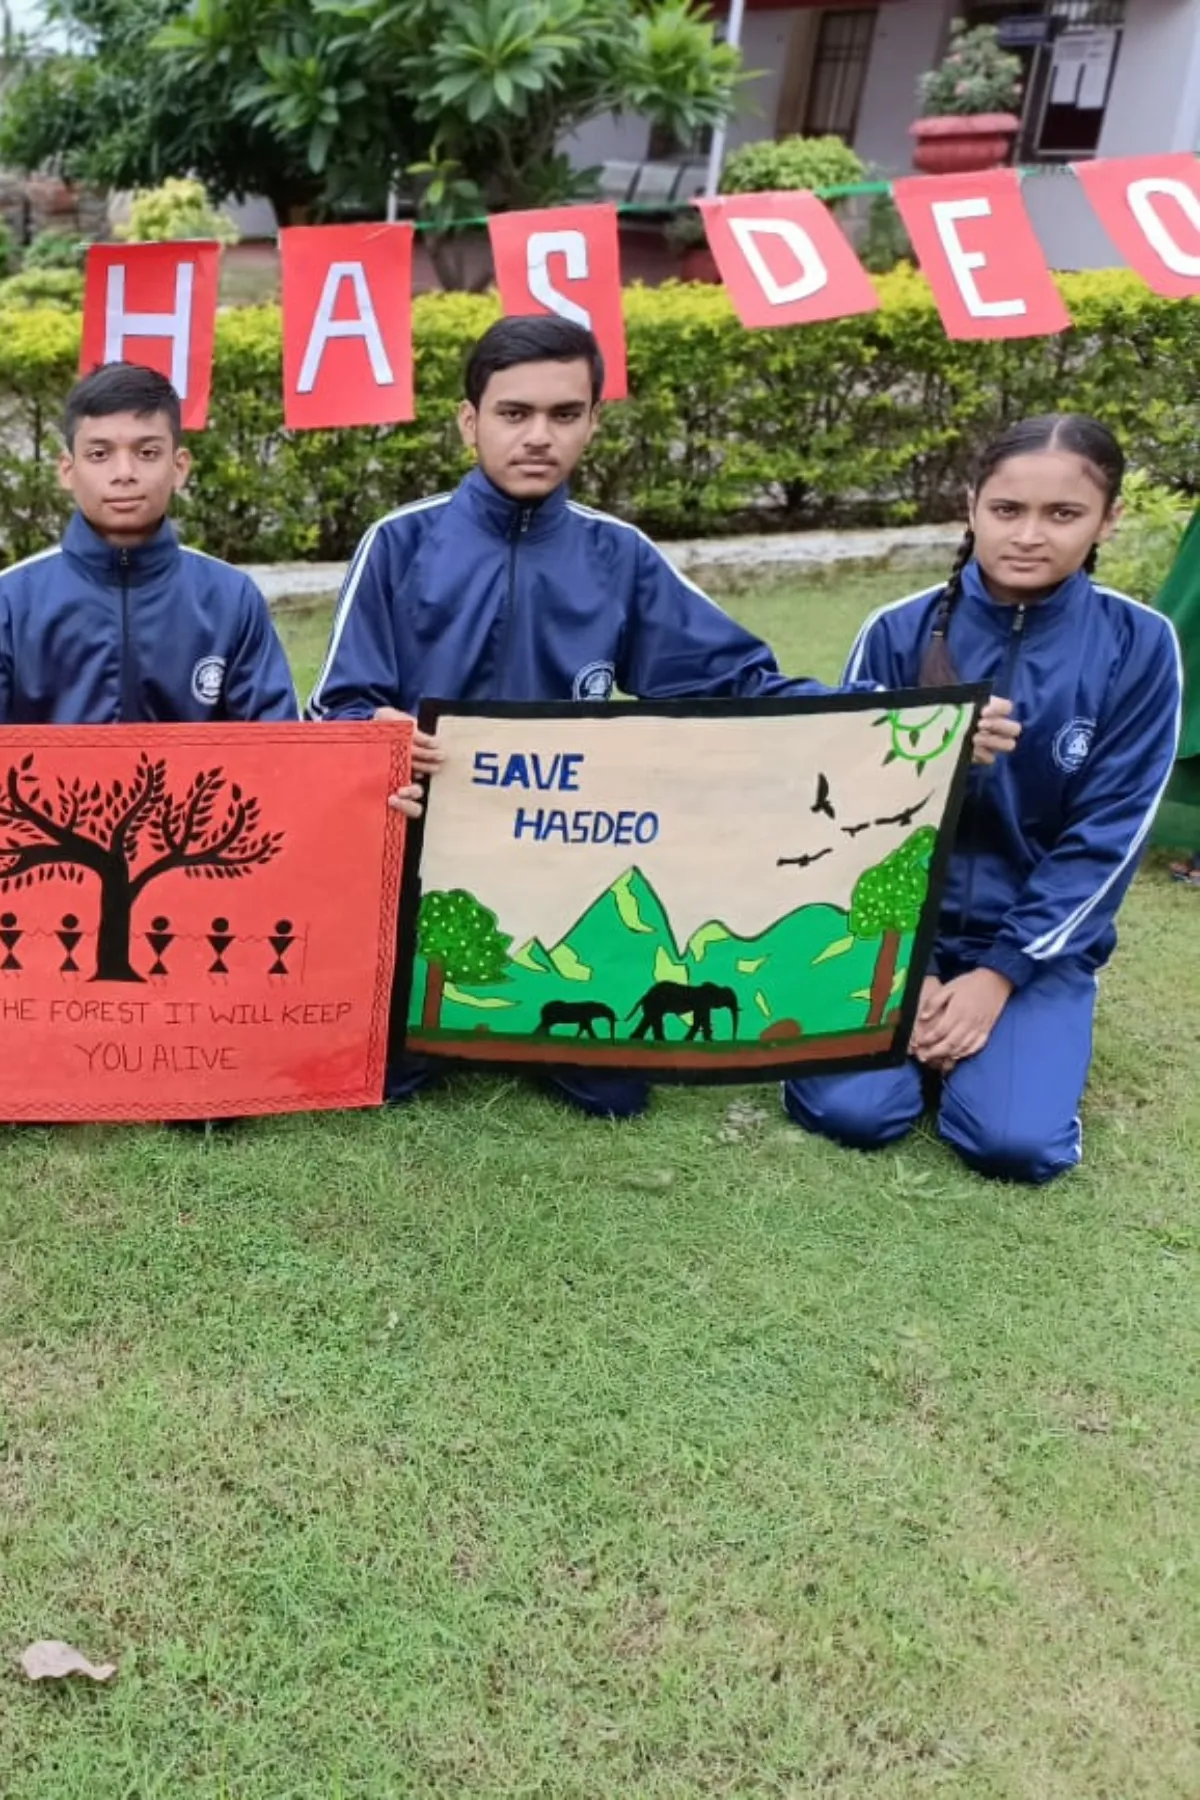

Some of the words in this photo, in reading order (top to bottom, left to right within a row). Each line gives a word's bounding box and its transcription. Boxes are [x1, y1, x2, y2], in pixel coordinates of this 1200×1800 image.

[471, 752, 584, 791] SAVE
[514, 807, 659, 846] HASDEO
[50, 1000, 151, 1025] FOREST
[165, 1002, 202, 1025] IT
[209, 1003, 274, 1025] WILL
[282, 1002, 353, 1025] KEEP
[74, 1041, 143, 1073] YOU
[153, 1044, 240, 1073] ALIVE
